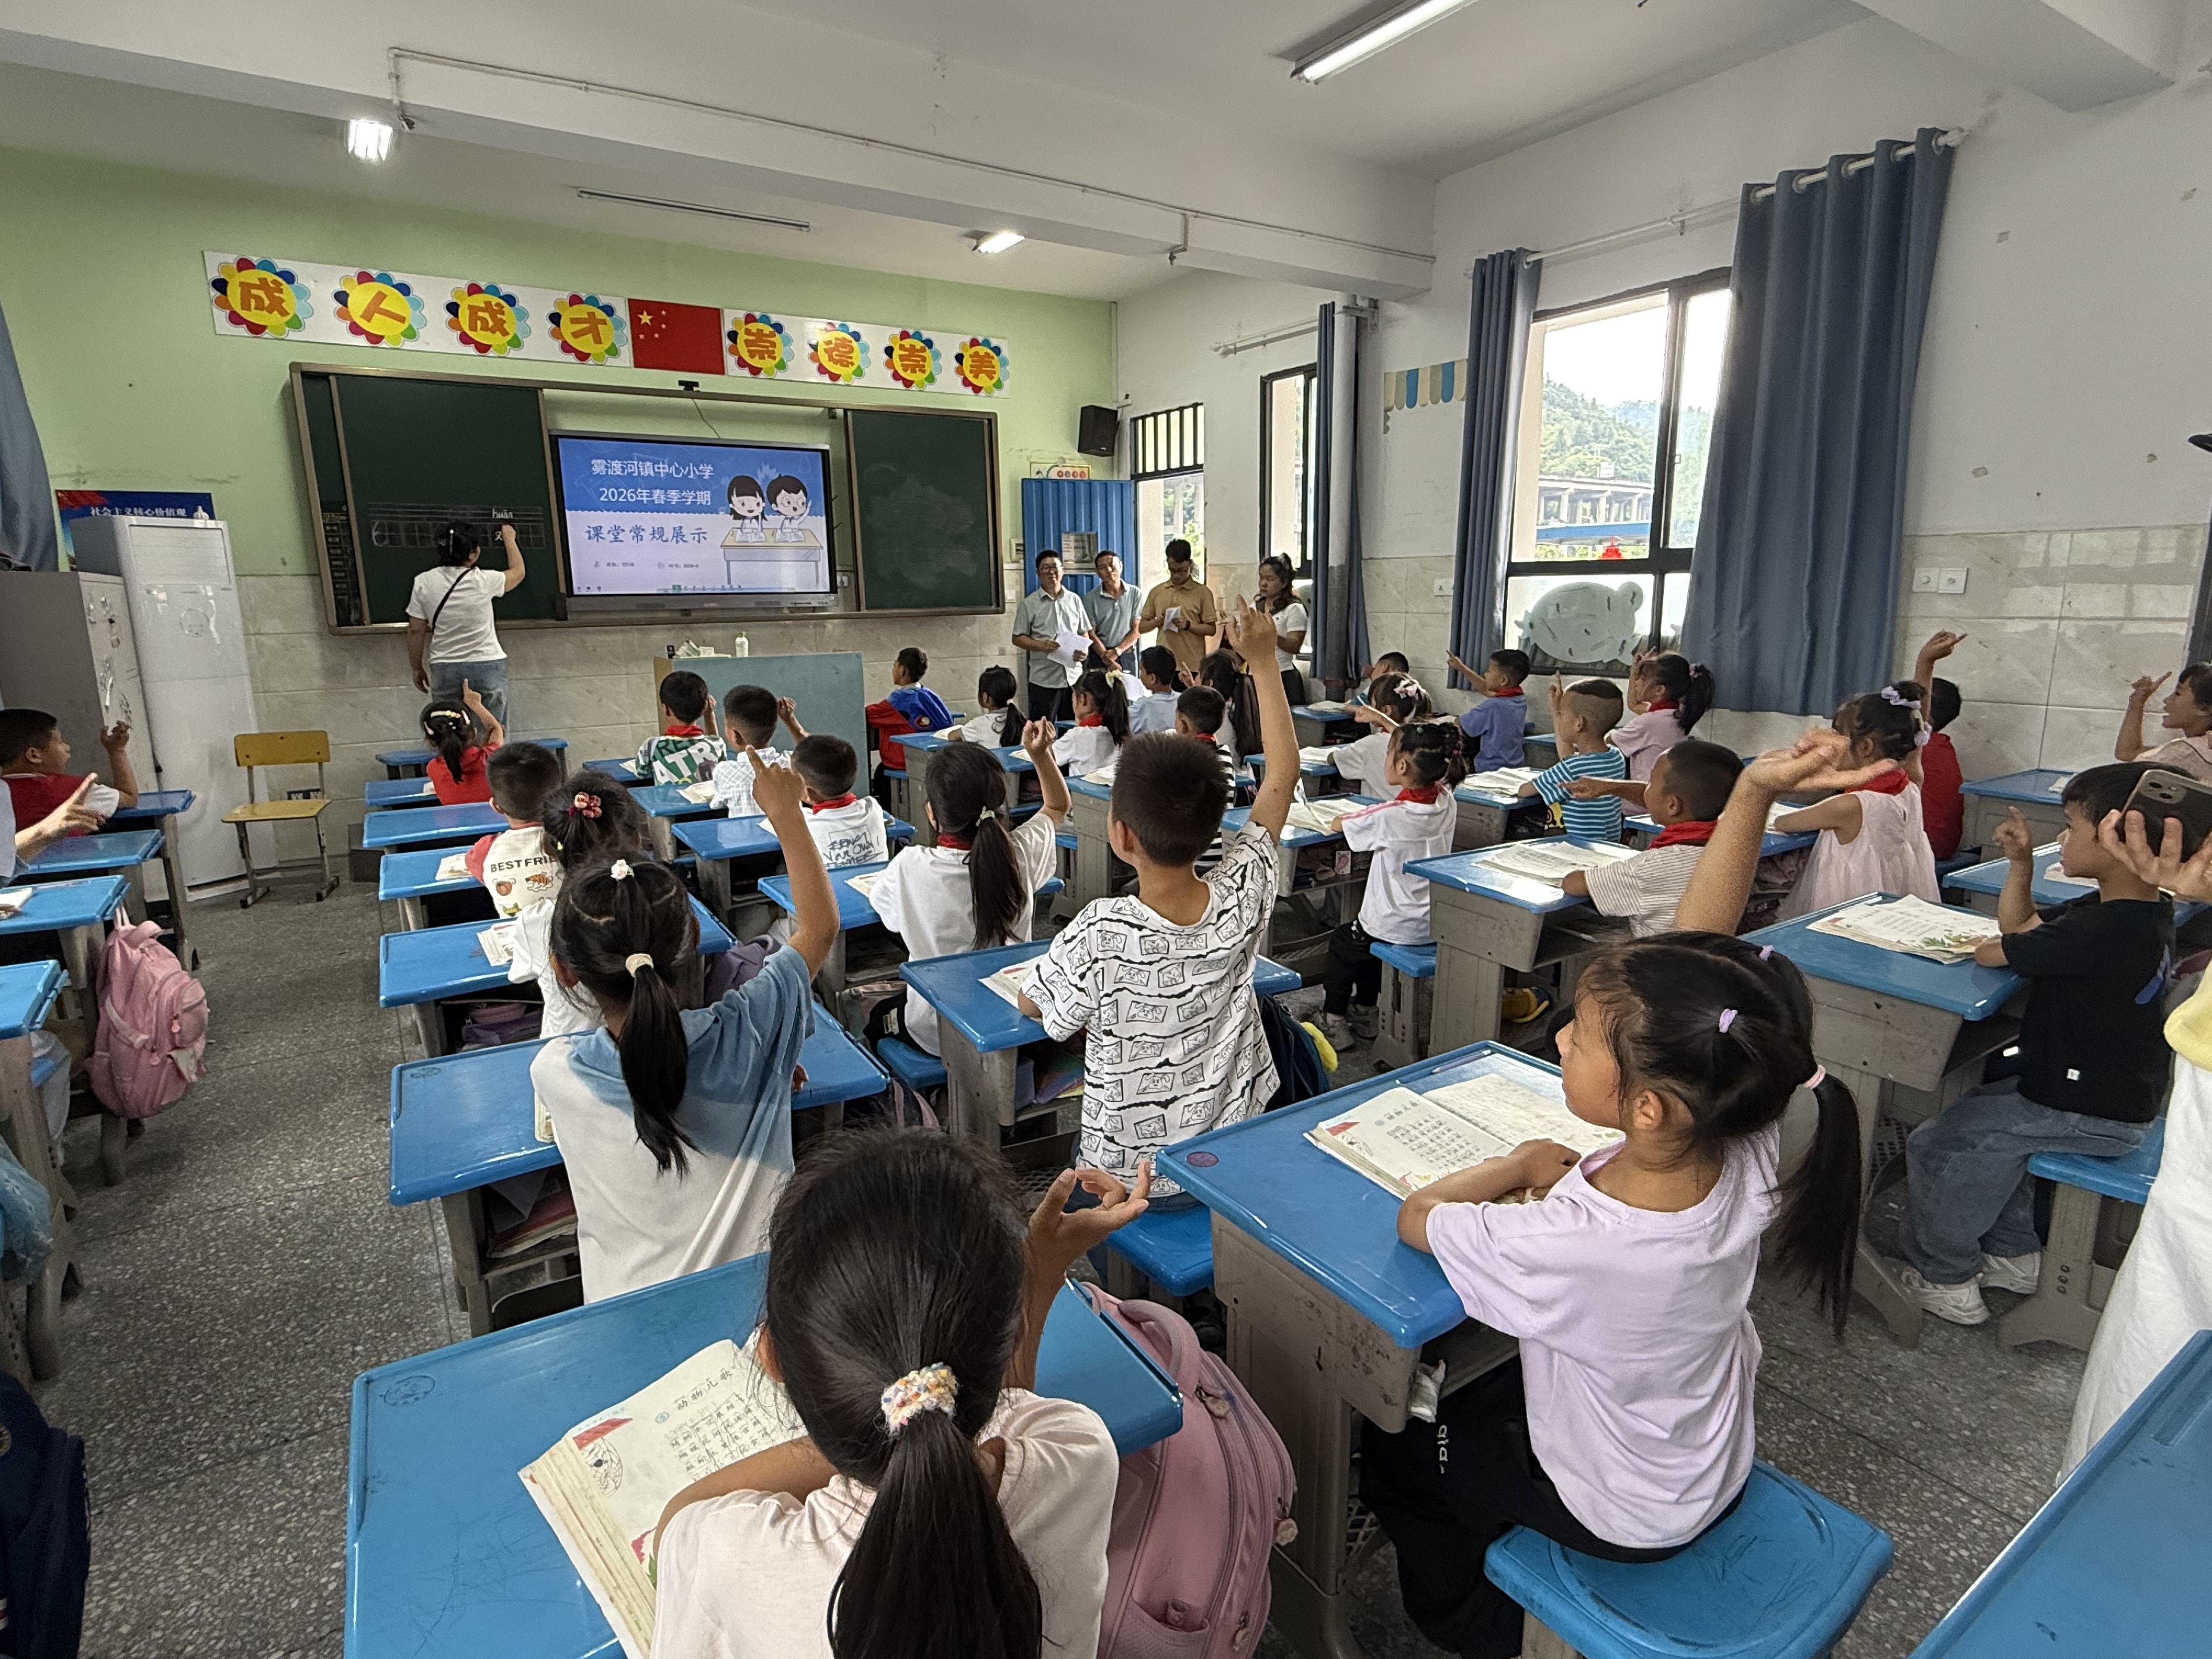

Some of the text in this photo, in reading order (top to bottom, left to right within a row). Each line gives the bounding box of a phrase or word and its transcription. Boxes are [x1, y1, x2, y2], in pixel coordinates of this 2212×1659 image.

[238, 277, 606, 345] 成人成才
[744, 328, 996, 380] 崇德崇美
[591, 459, 715, 479] 雾渡河镇中心小学
[599, 488, 711, 506] 2026年春季学期
[90, 506, 188, 517] 社会主义核心价值观
[584, 524, 708, 545] 课堂常规展示
[490, 859, 522, 873] BEST
[676, 1370, 733, 1410] 动物儿歌
